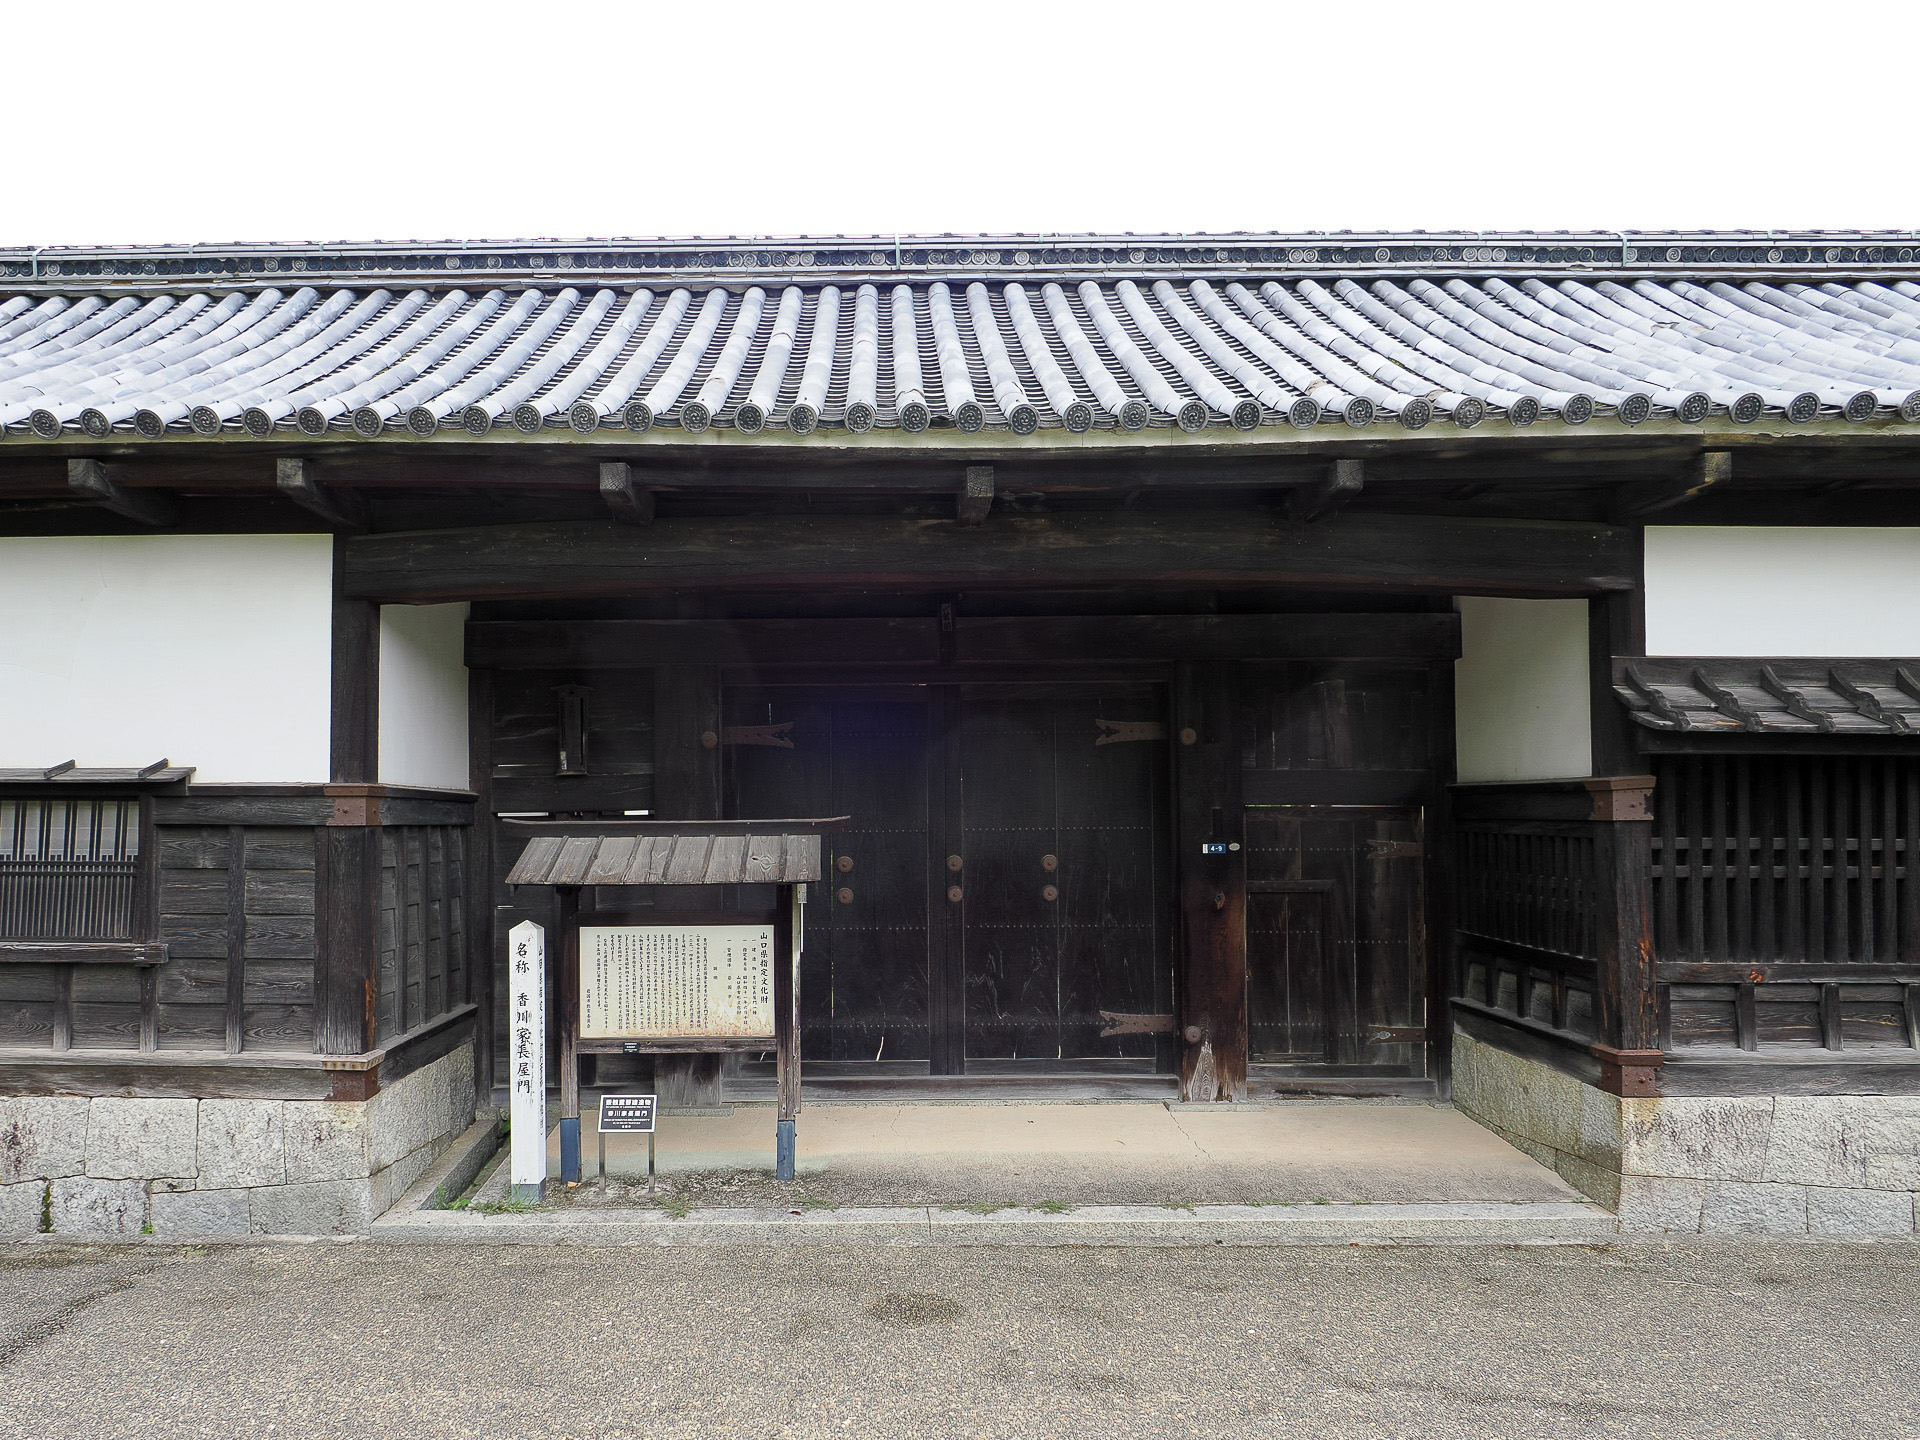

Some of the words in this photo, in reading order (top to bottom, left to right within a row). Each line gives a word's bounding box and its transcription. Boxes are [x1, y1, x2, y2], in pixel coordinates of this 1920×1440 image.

[515, 942, 530, 974] 名称
[760, 932, 769, 1004] 山口県指定文化財
[515, 993, 531, 1094] 香川家長屋門
